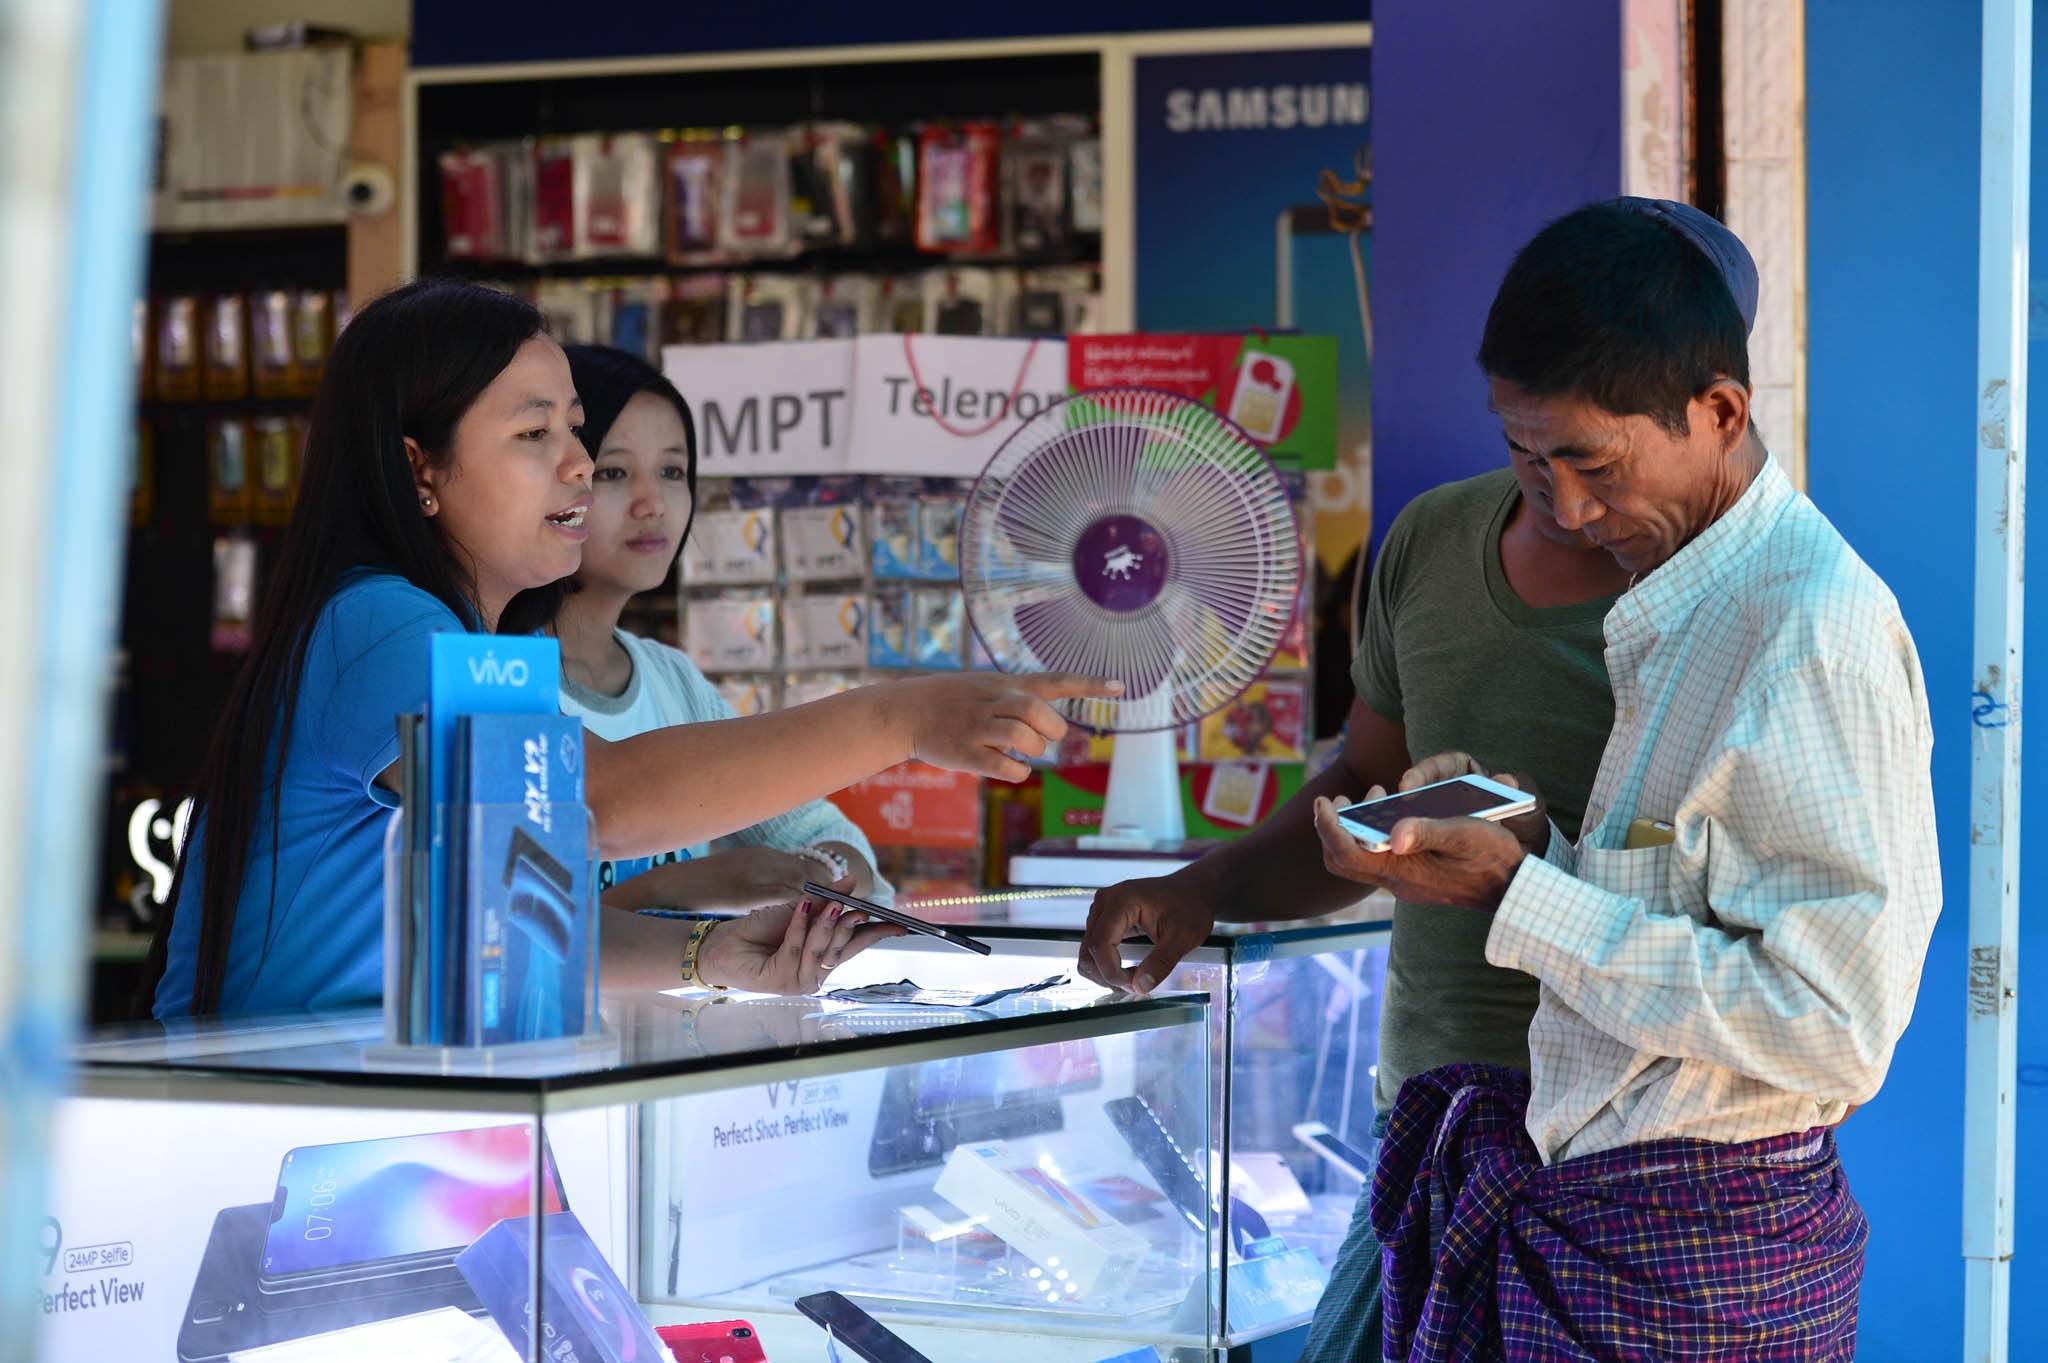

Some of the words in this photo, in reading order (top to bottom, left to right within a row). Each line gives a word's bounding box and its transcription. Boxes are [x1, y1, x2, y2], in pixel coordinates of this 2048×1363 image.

[1165, 84, 1368, 132] SAMSUN
[700, 390, 847, 459] MPT
[712, 1121, 754, 1150] Perfect
[783, 1109, 822, 1136] Perfect
[822, 1107, 849, 1129] View
[40, 1215, 63, 1277] 9
[69, 1250, 99, 1269] 24MP
[100, 1246, 130, 1265] Selfie
[100, 1276, 145, 1307] View
